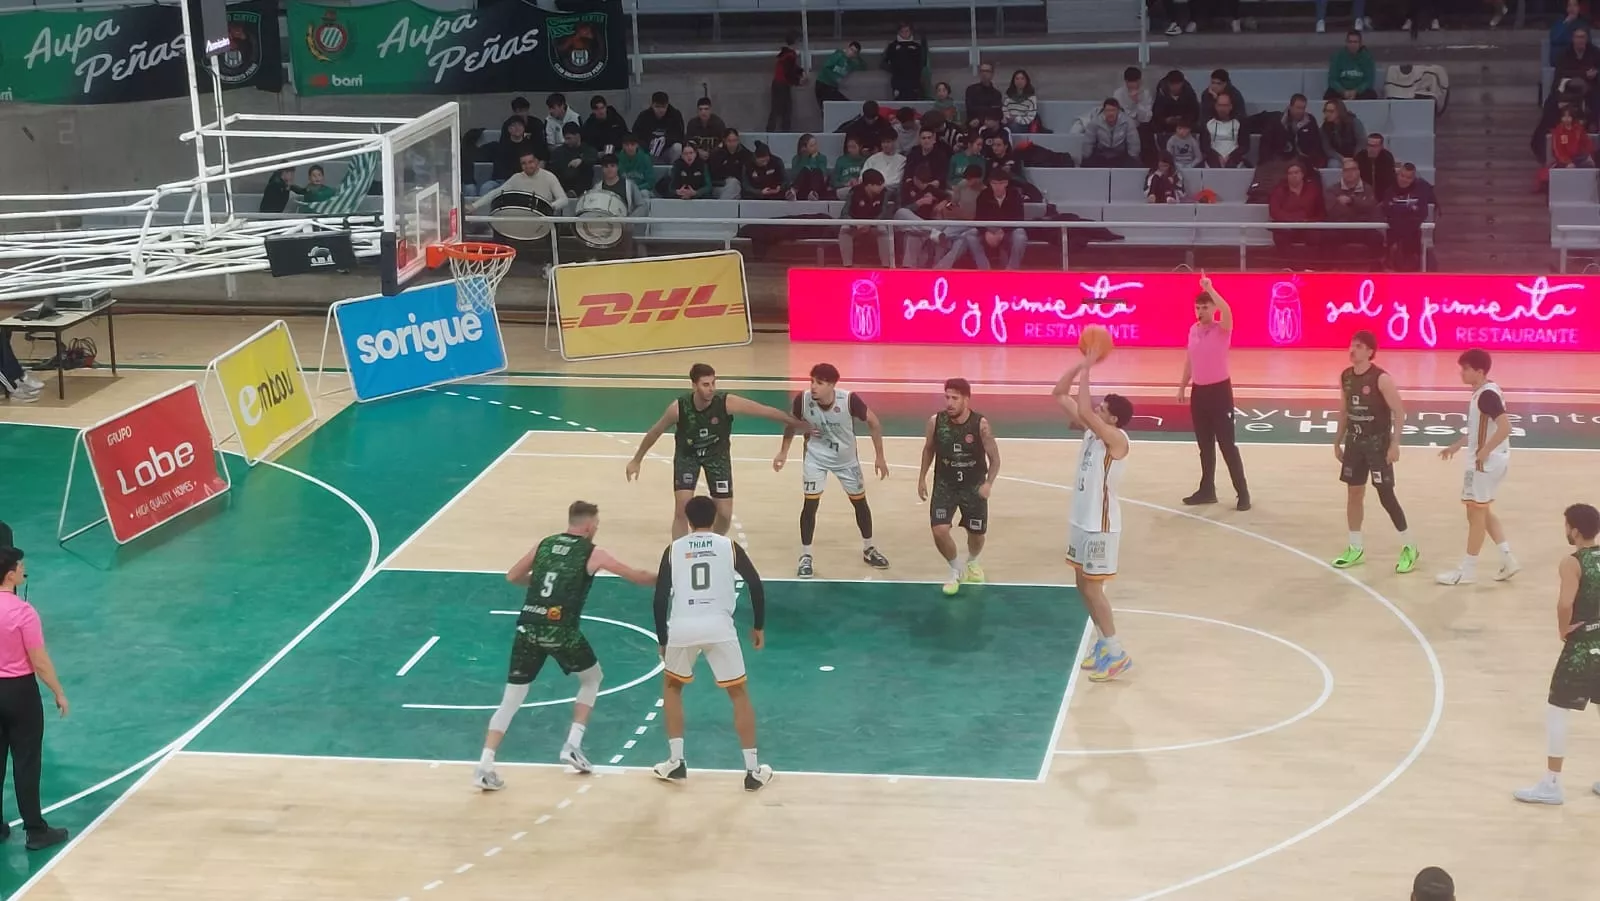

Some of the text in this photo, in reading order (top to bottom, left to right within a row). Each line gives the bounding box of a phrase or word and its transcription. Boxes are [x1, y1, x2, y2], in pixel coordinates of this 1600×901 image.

[24, 17, 120, 69] Aupa
[377, 12, 477, 58] Aupa
[428, 28, 539, 84] Peñas
[0, 87, 13, 101] rri
[332, 74, 363, 87] barri
[578, 284, 729, 328] DHL
[961, 299, 980, 337] y
[1024, 322, 1140, 340] RESTANTE
[1388, 301, 1408, 341] y
[1456, 326, 1579, 345] RESTAURANTE
[239, 367, 294, 426] embou
[107, 426, 132, 446] GRUPO
[116, 441, 195, 496] Lobe
[957, 470, 964, 482] 3
[149, 490, 172, 511] QUALITY
[172, 480, 194, 498] HOMES
[803, 481, 816, 491] 77
[689, 540, 713, 549] THIAM
[540, 572, 558, 598] 5
[691, 562, 710, 591] 0
